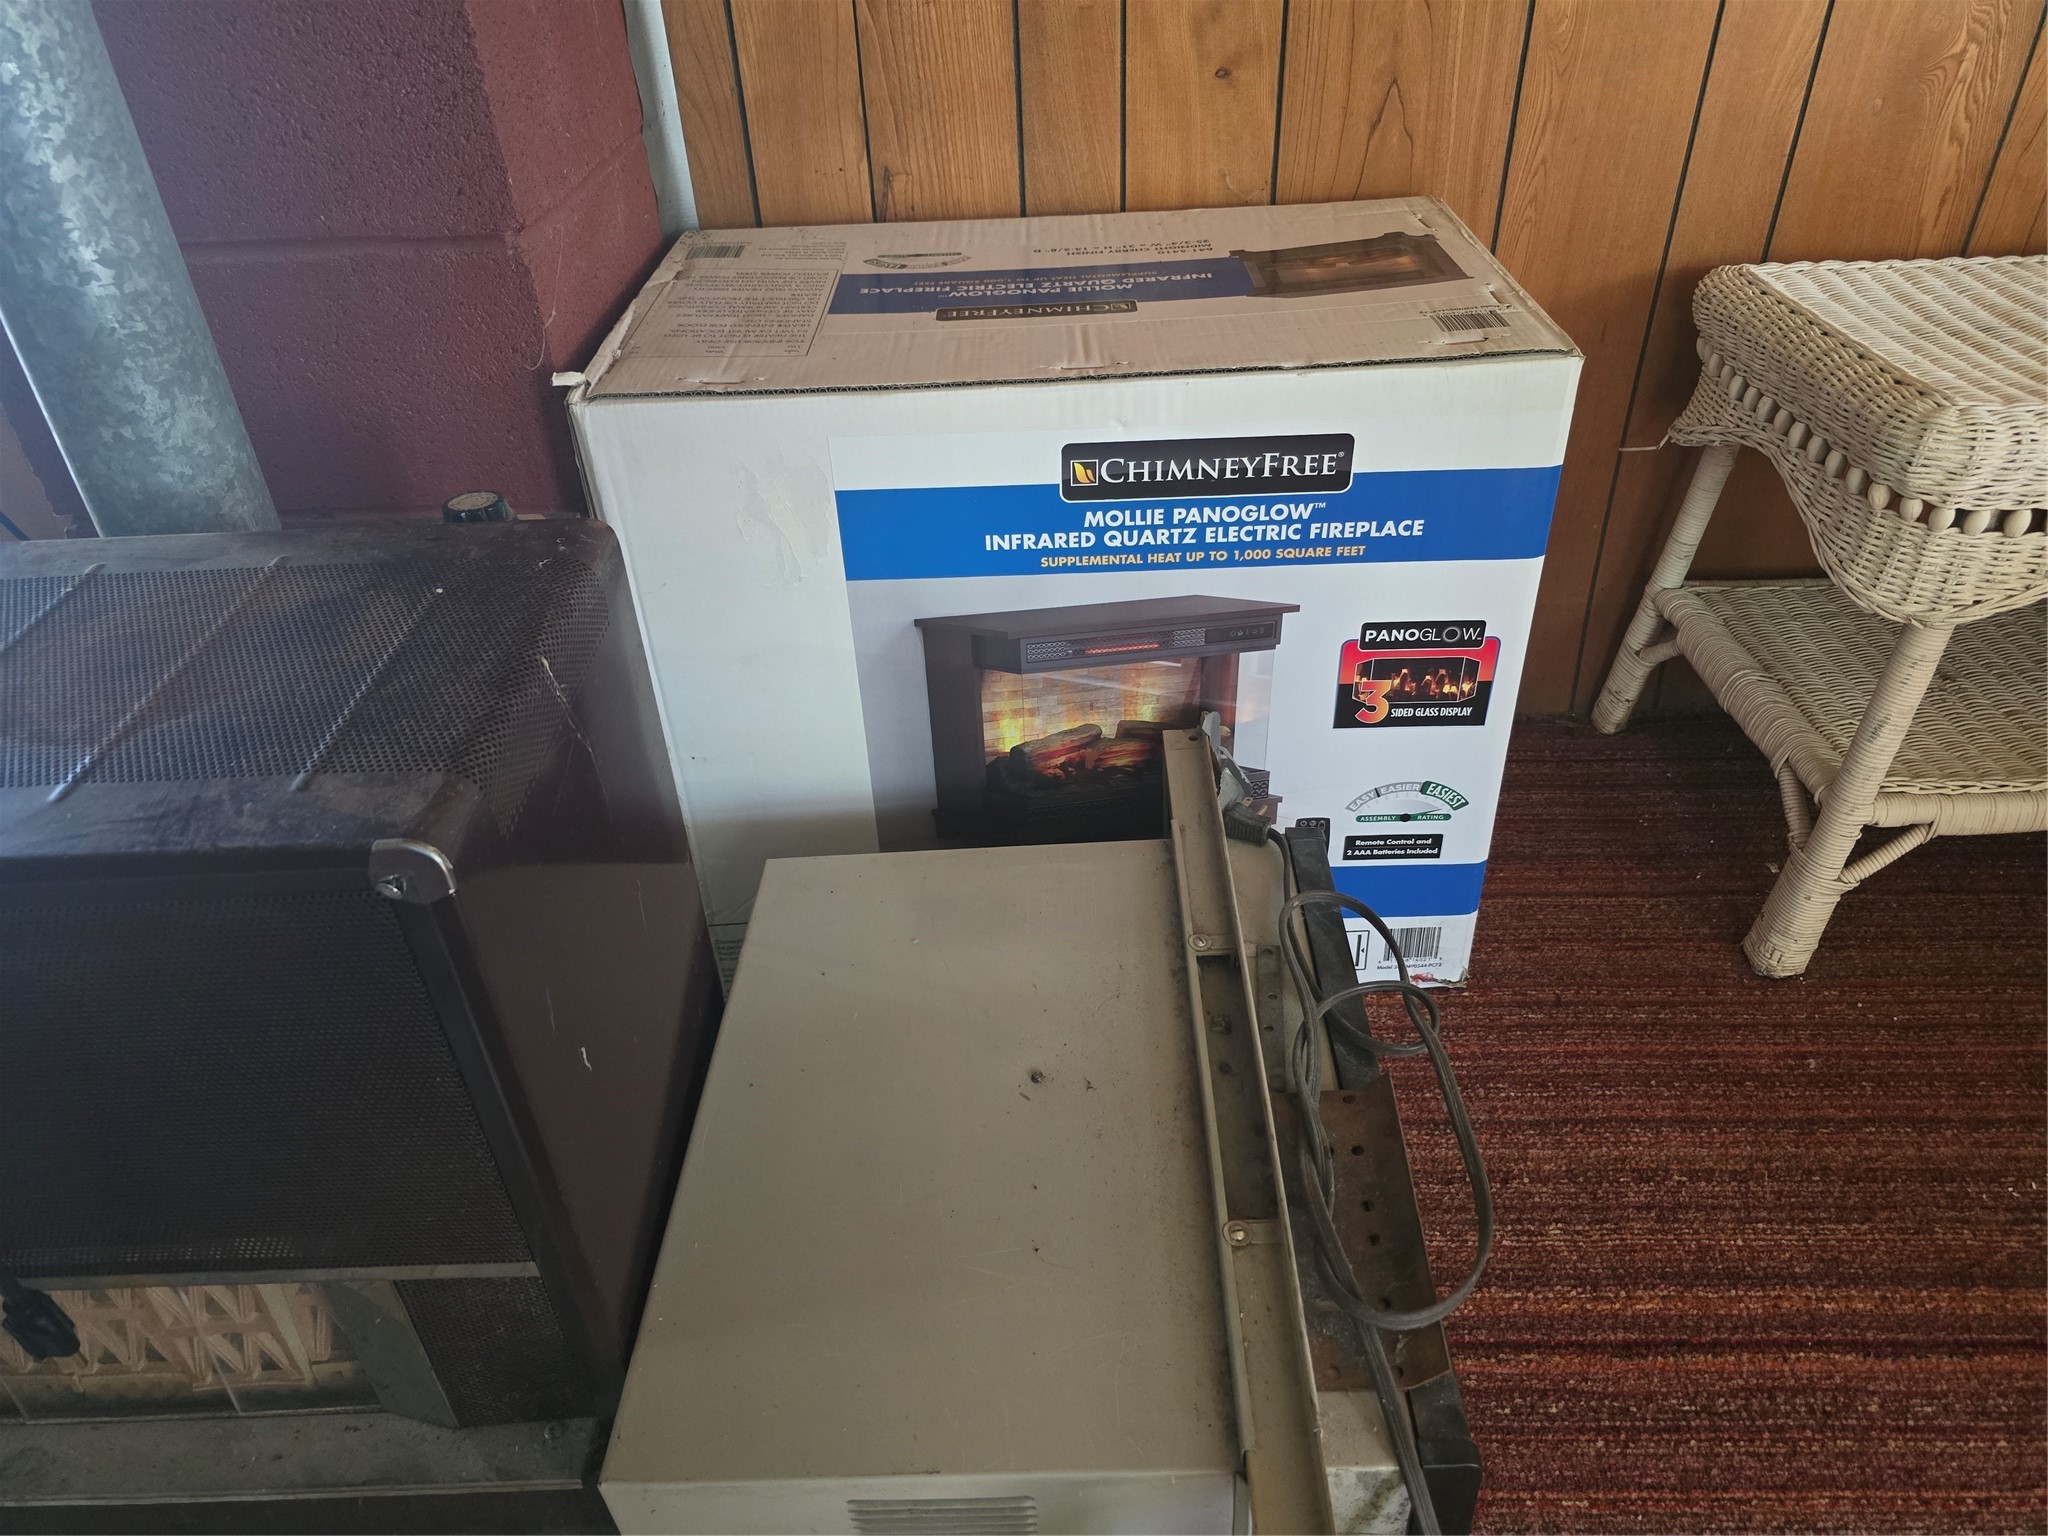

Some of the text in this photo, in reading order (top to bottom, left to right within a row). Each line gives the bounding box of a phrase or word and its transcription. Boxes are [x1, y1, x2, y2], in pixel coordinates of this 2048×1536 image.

[860, 273, 1213, 294] INFRARED QUARTZ ELECTRIC FIREPLACE
[1067, 284, 1133, 293] MOLLIE
[1083, 507, 1164, 528] MOLLIE
[984, 519, 1424, 551] INFRARED QUARTZ ELECTRIC FIREPLACE
[1040, 546, 1366, 567] SUPPLEMENTAL HEAT UP TO 1,000 SQUARE FEET
[1355, 680, 1472, 723] 3 SIDED GLASS DISPLAY
[1350, 783, 1466, 810] EASY EASIER EASIEST
